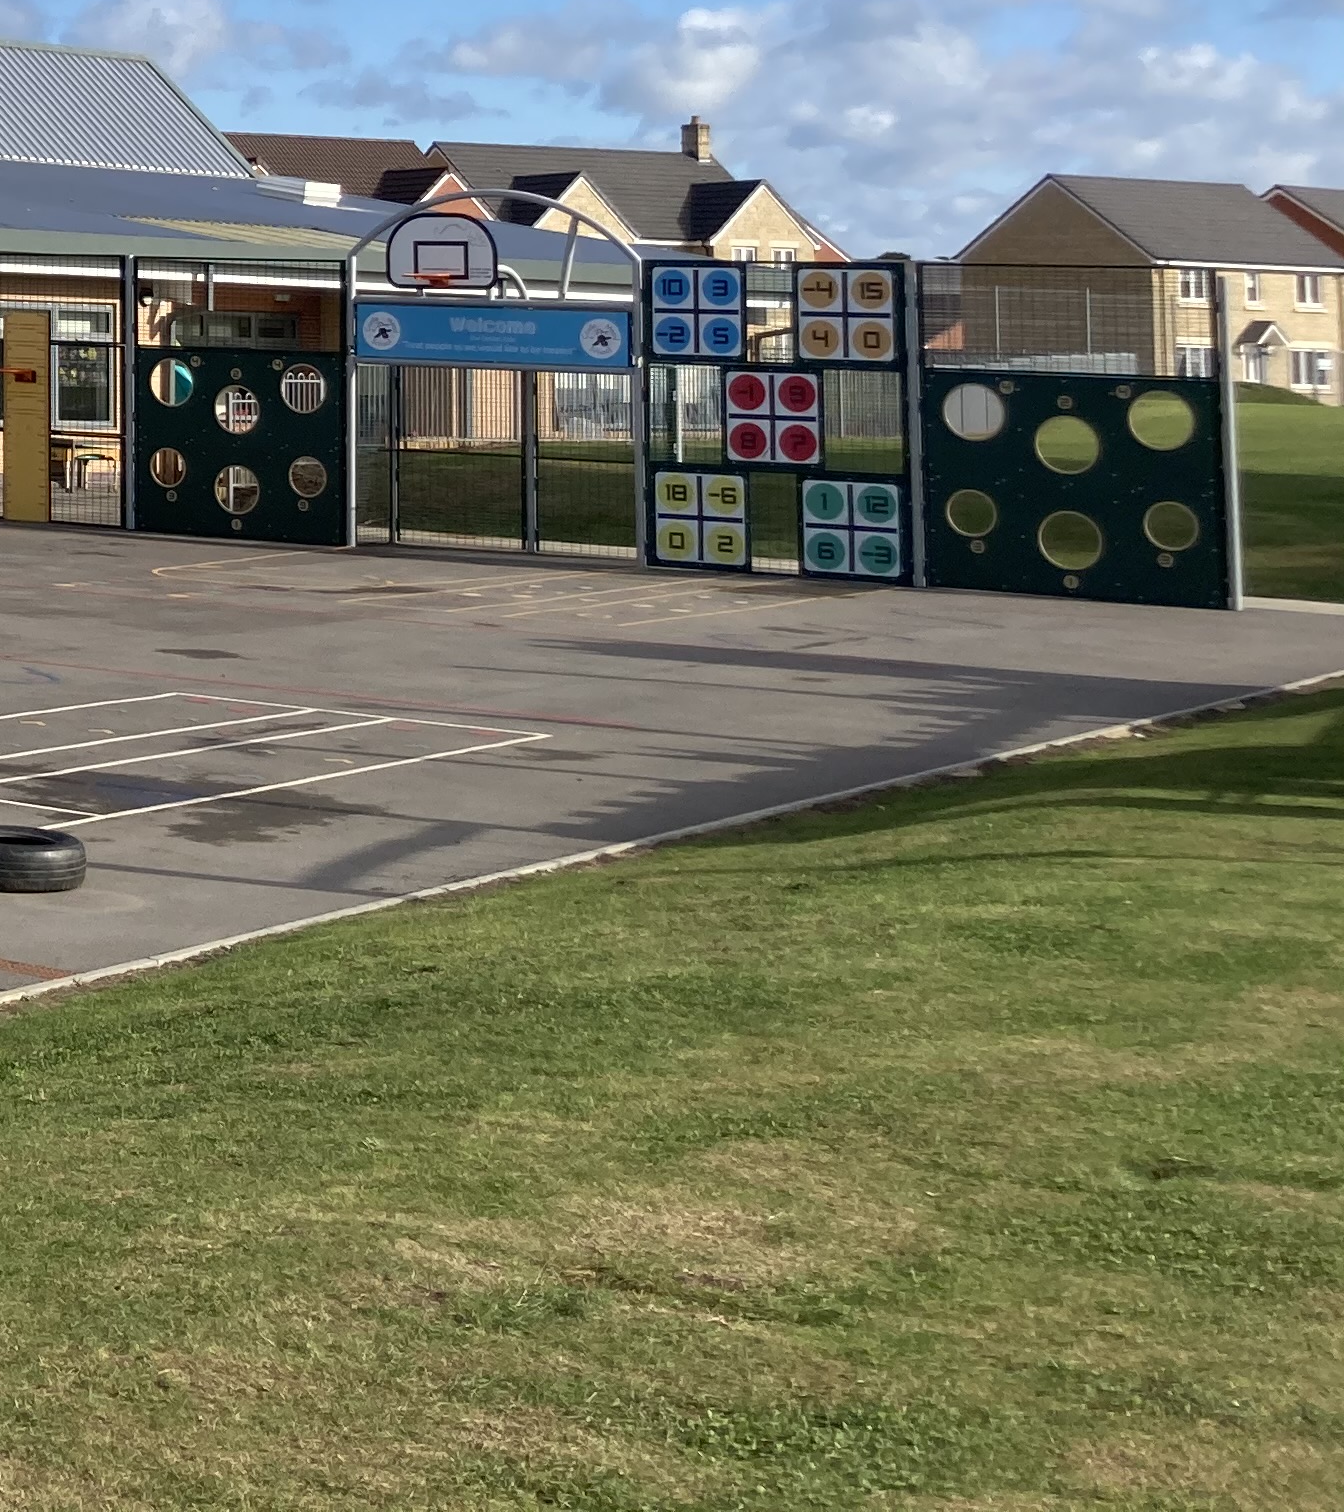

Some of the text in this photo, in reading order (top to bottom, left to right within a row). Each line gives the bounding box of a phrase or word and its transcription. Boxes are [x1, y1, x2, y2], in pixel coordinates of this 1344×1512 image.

[662, 278, 683, 296] 10
[712, 279, 728, 297] 3
[803, 281, 833, 299] -4
[860, 282, 883, 300] 15
[656, 326, 685, 344] -2
[713, 327, 729, 345] 5
[813, 330, 829, 348] 4
[863, 331, 880, 349] 0
[740, 432, 756, 450] 8
[790, 433, 807, 452] 7
[665, 484, 688, 502] 18
[709, 486, 737, 505] -6
[820, 492, 828, 511] 1
[865, 495, 889, 515] 12
[669, 531, 685, 550] 0
[717, 534, 734, 554] 2
[817, 541, 835, 560] 6
[861, 545, 892, 565] -3
